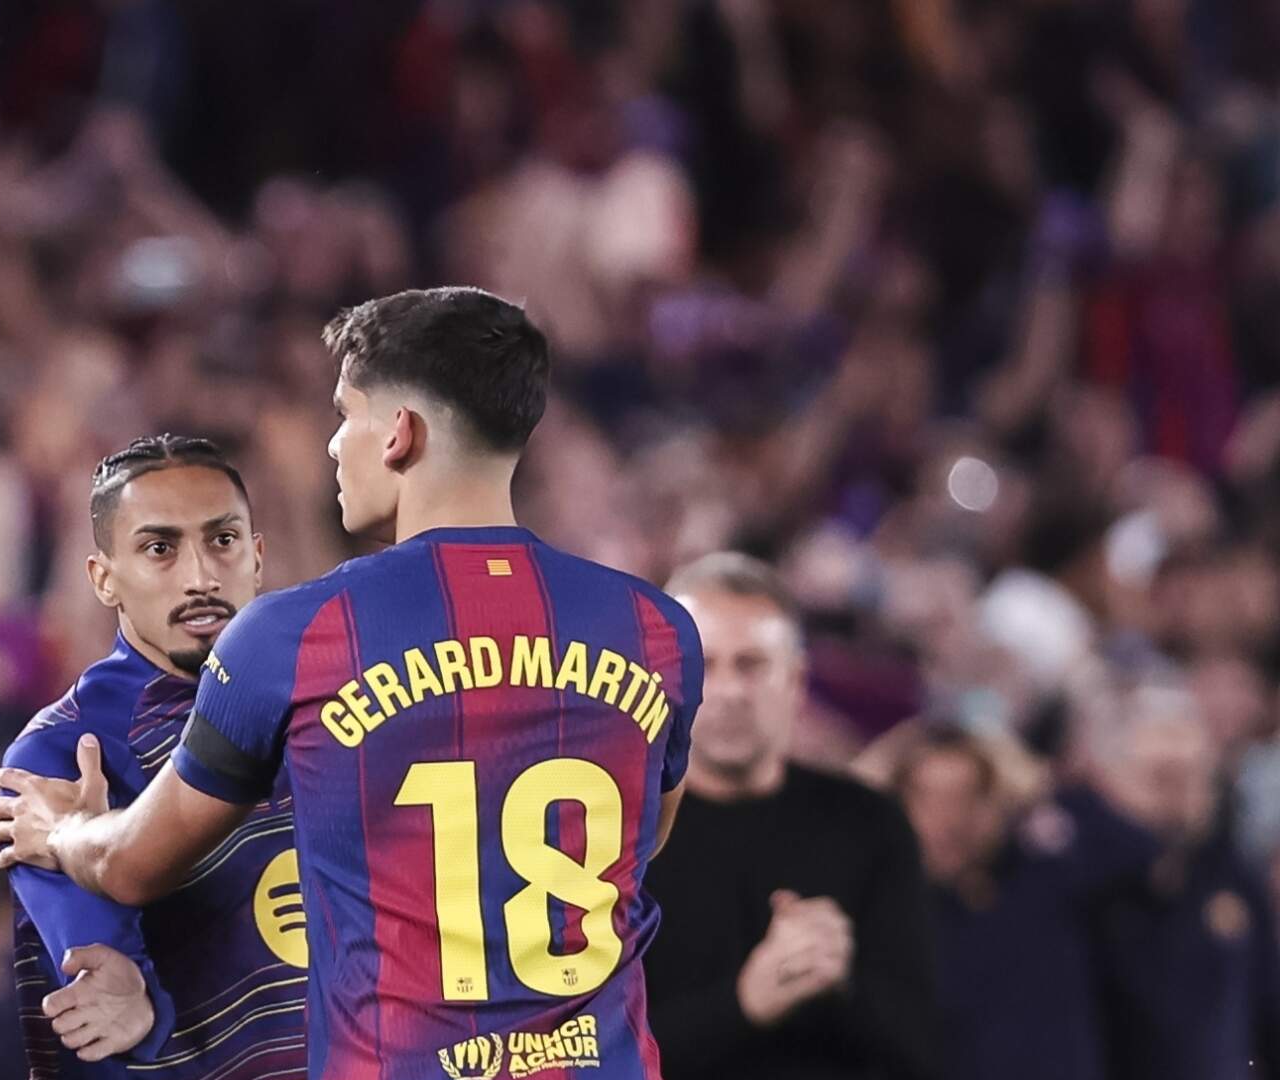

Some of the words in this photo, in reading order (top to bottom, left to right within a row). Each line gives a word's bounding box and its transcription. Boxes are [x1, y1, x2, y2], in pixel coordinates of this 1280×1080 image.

[319, 635, 504, 749] GERARD
[392, 757, 624, 1002] 18
[508, 1014, 597, 1054] UNHCR
[508, 1037, 600, 1074] ACNUR
